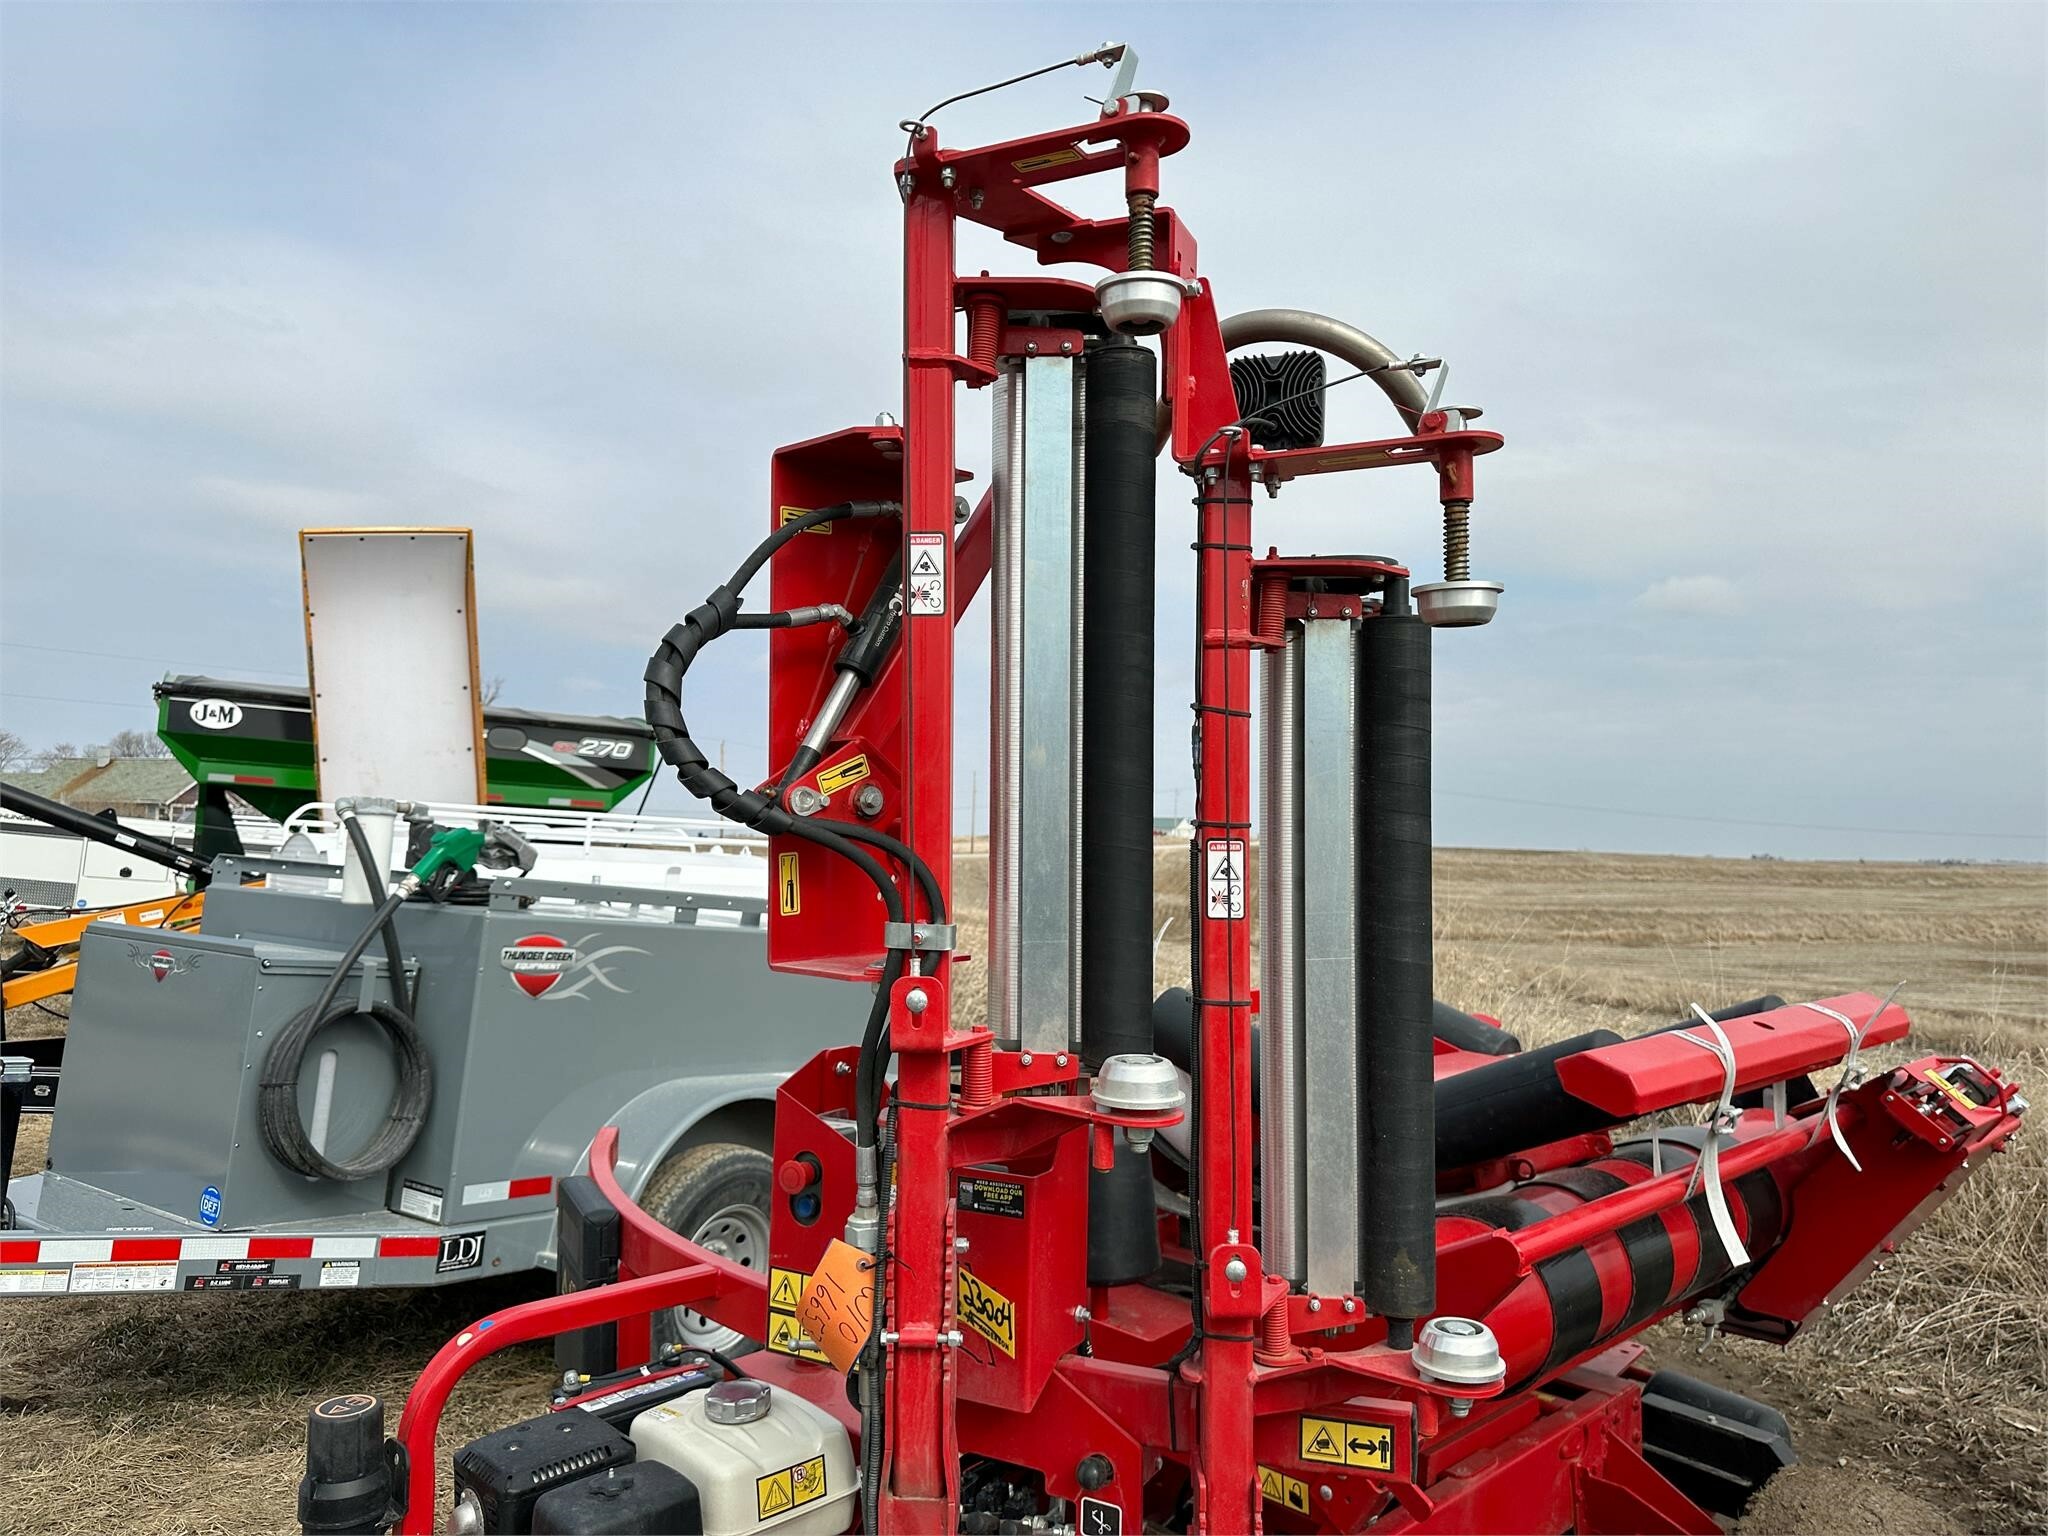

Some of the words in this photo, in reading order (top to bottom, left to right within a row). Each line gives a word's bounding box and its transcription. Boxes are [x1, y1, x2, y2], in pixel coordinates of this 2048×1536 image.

[194, 704, 235, 723] J&M
[577, 739, 634, 759] 270
[503, 951, 544, 961] THUNDER
[545, 952, 575, 961] CREEK
[974, 1183, 1009, 1194] DOWNLOAD
[1009, 1188, 1023, 1196] OUR
[983, 1191, 999, 1200] FREE
[203, 1198, 218, 1212] DEF
[441, 1235, 484, 1266] LDJ
